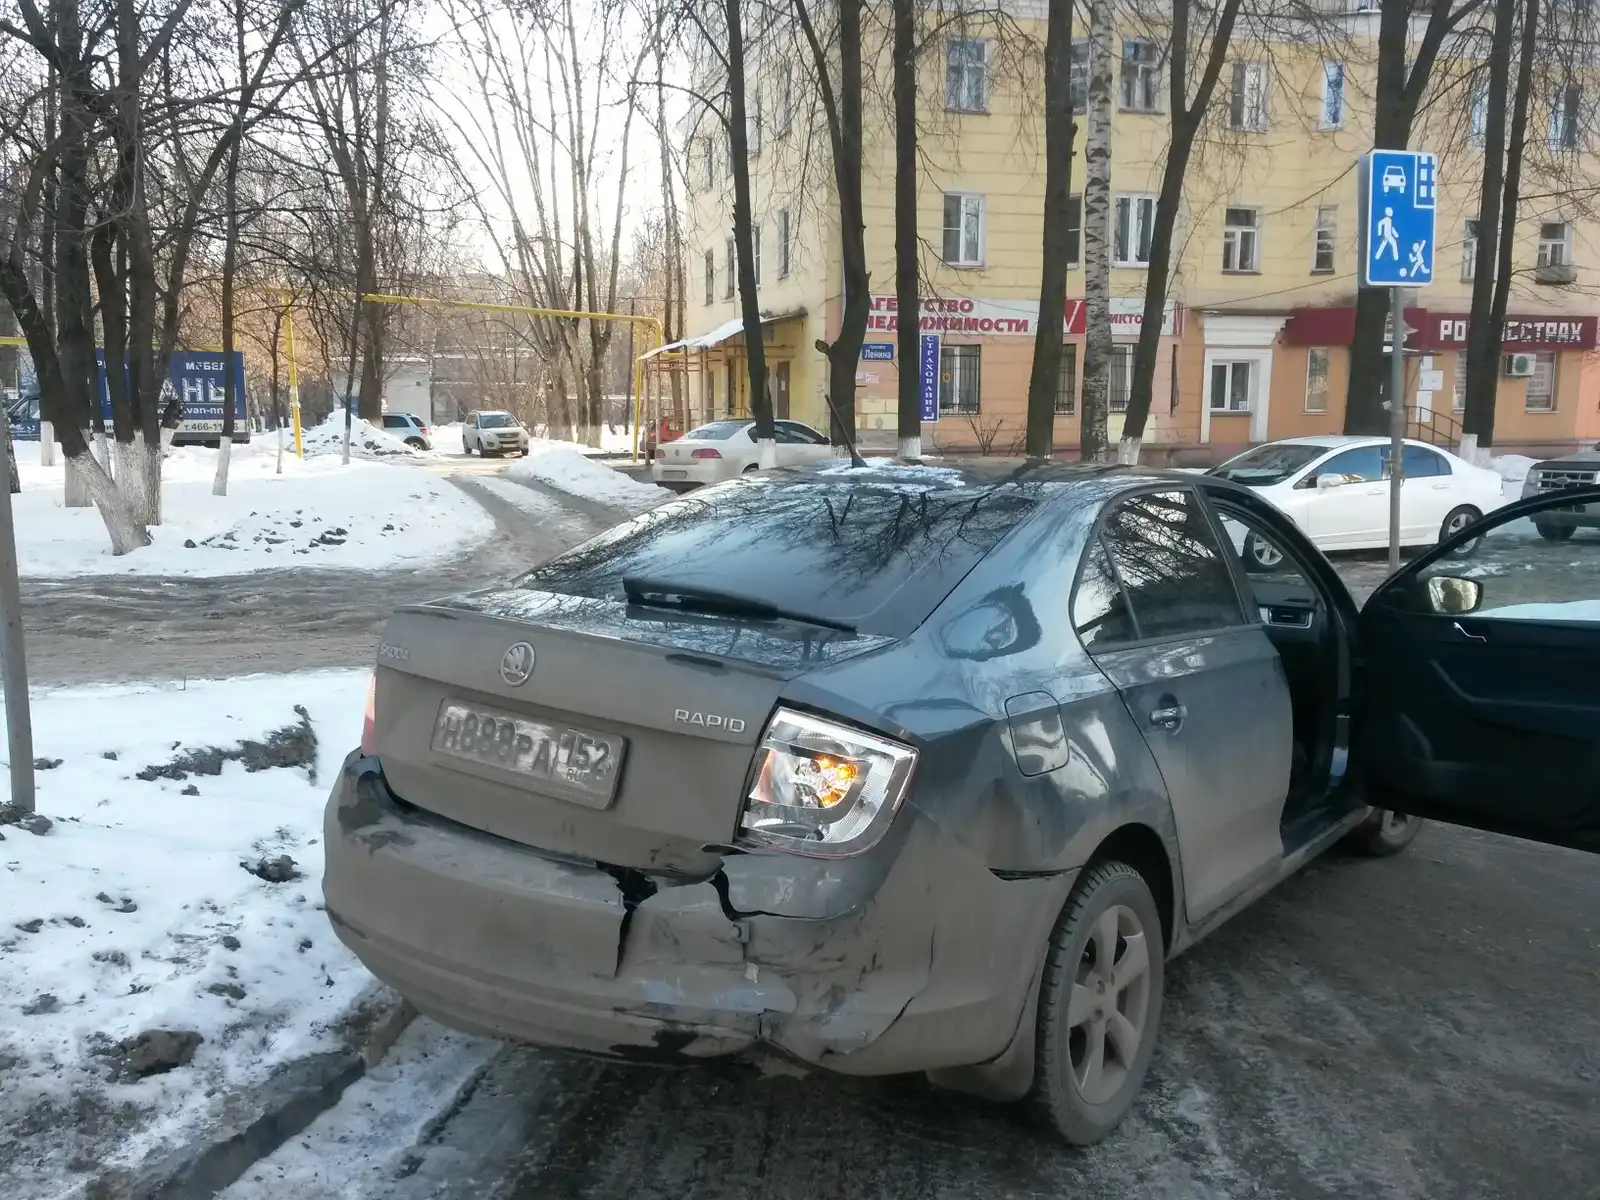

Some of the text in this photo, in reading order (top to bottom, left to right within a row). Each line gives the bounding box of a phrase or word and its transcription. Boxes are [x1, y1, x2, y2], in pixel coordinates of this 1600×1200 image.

[868, 297, 973, 314] ГЕСТВО
[867, 315, 1029, 333] НЕДИЖИМОСТИ
[1439, 319, 1584, 343] РОССТРАХ
[864, 349, 892, 359] Ленина
[924, 335, 935, 413] СТРАХОВАНИЕ
[673, 708, 745, 734] RAPID
